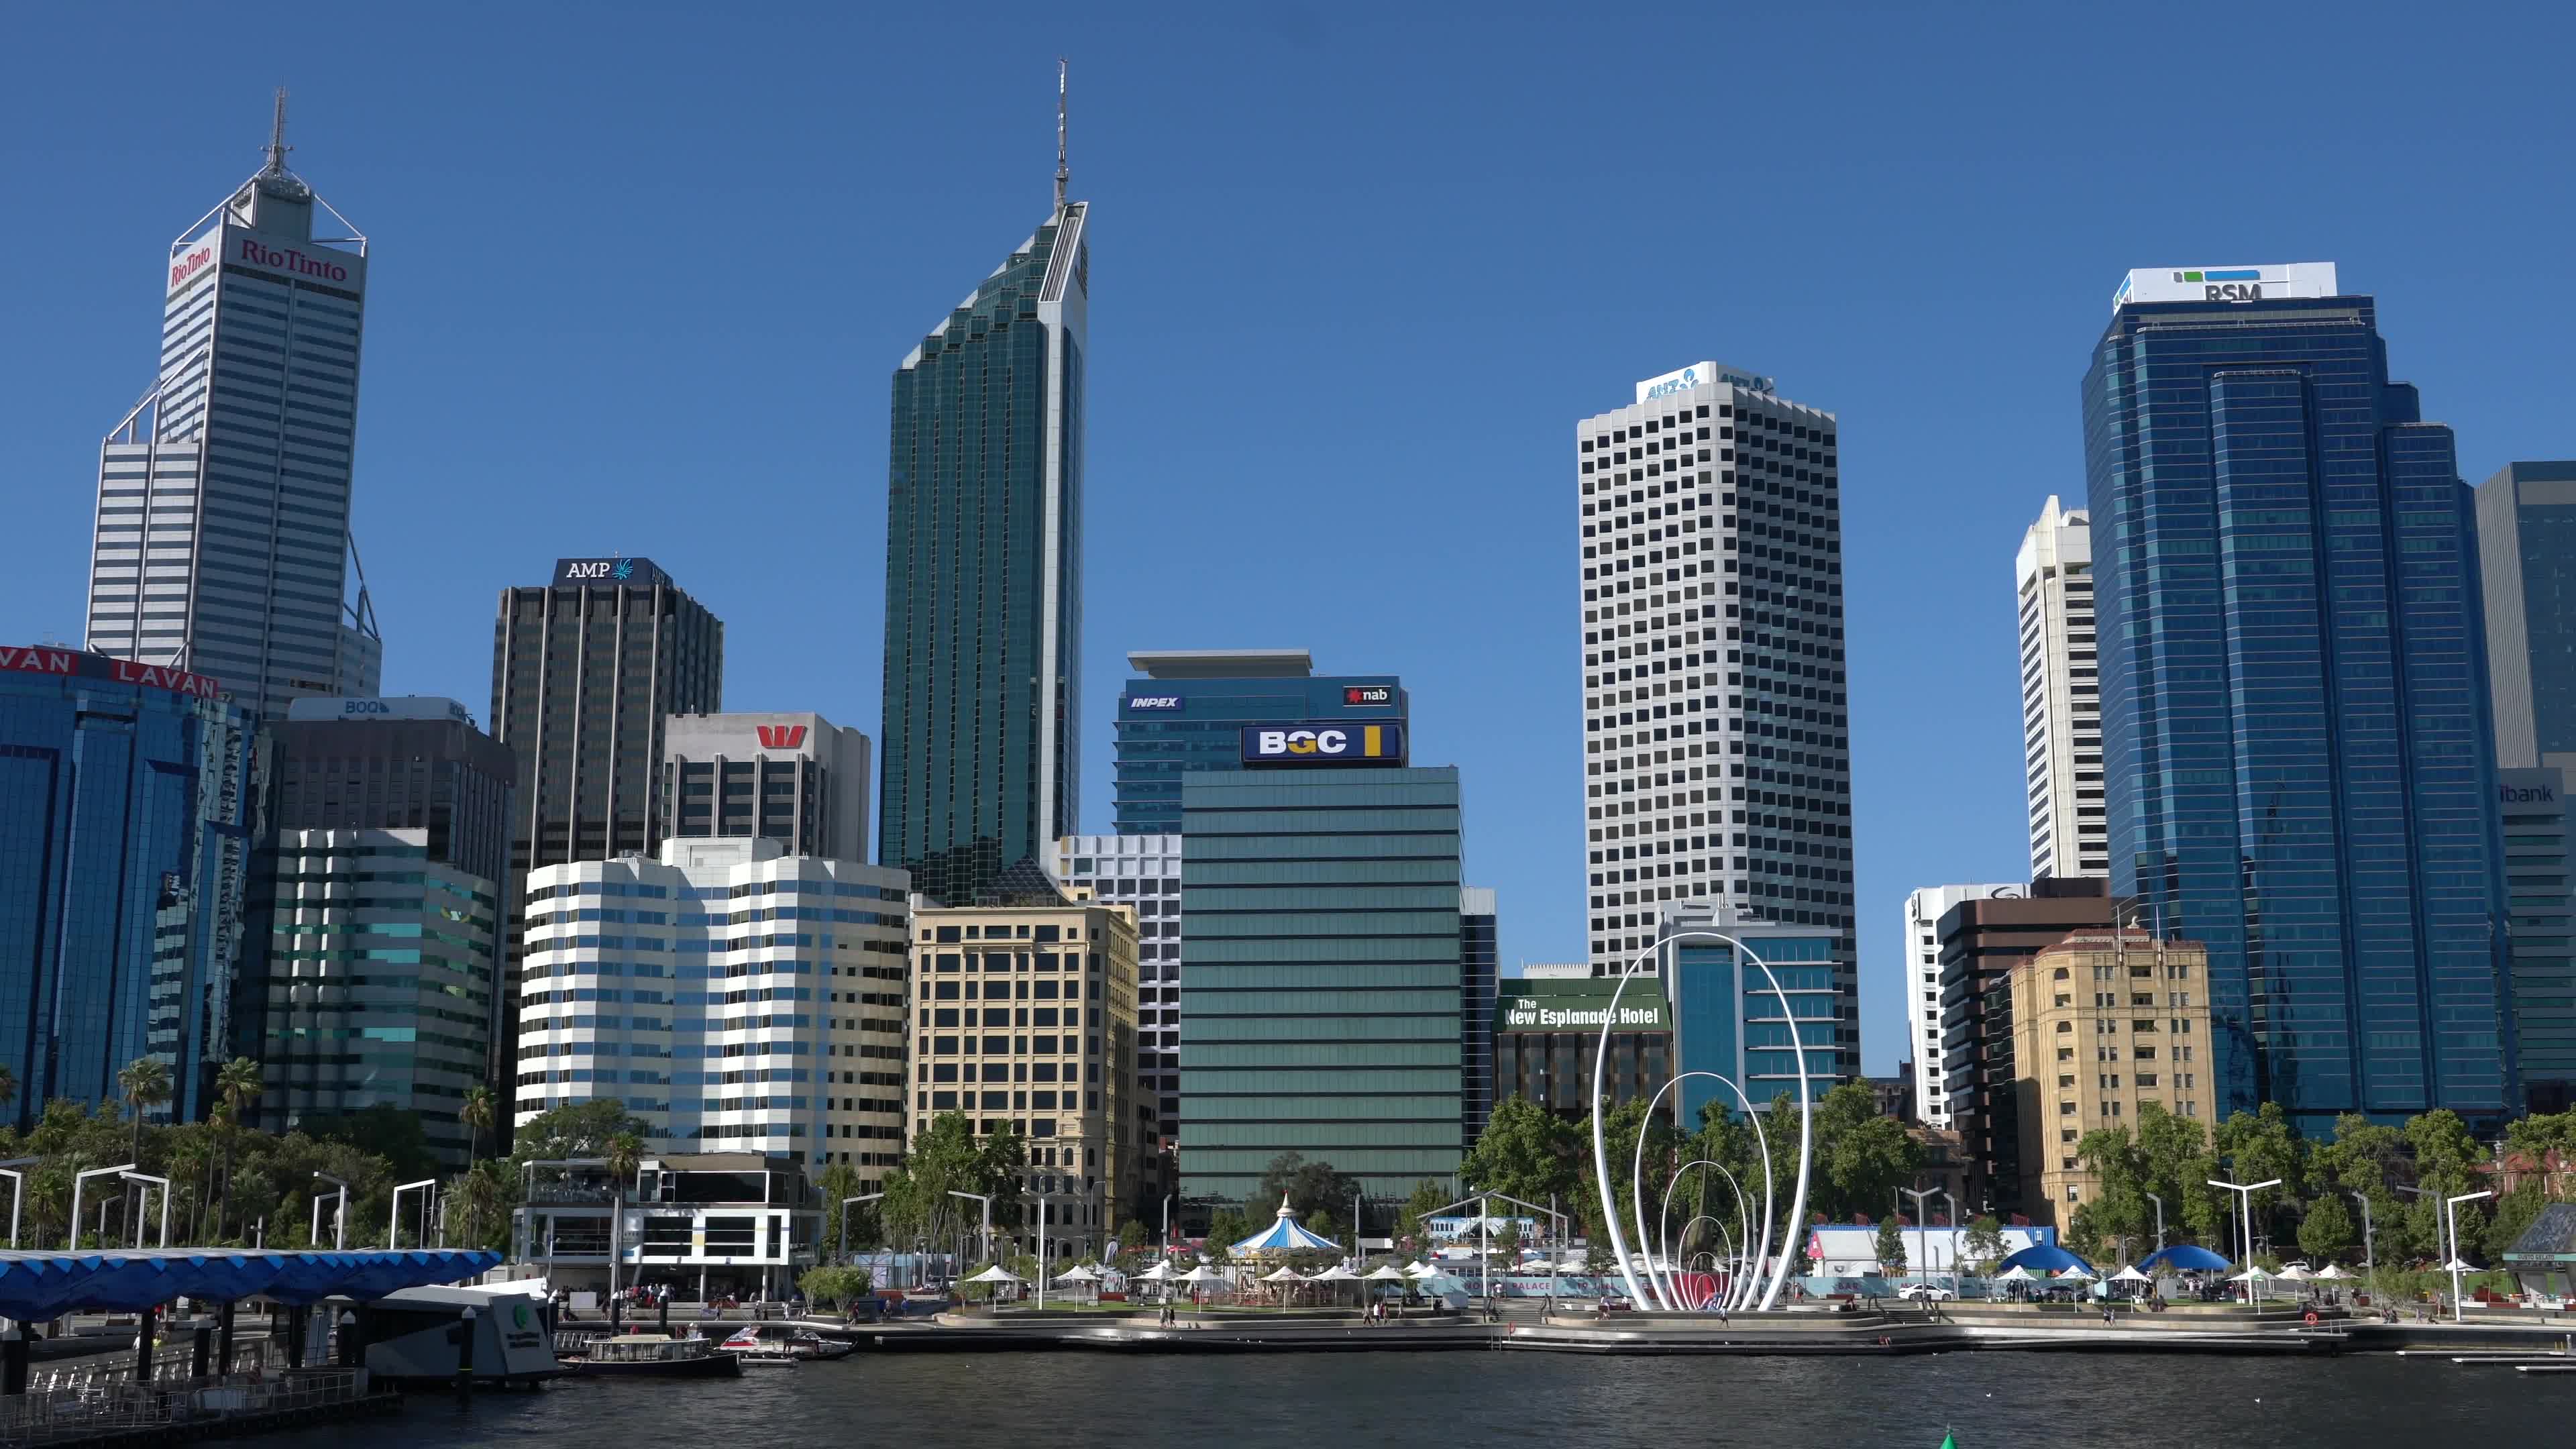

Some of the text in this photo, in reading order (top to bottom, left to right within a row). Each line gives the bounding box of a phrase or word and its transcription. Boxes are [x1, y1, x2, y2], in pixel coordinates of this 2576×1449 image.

[2205, 283, 2262, 301] RSM
[566, 562, 610, 578] AMP
[118, 661, 215, 696] LAVAN
[1130, 697, 1179, 708] INPEX
[1362, 689, 1388, 702] nab
[1259, 730, 1346, 754] BGC
[1518, 999, 1537, 1009] The
[1505, 1009, 1537, 1024] New
[1621, 1008, 1658, 1024] Hotel
[1513, 1282, 1551, 1290] PALACE
